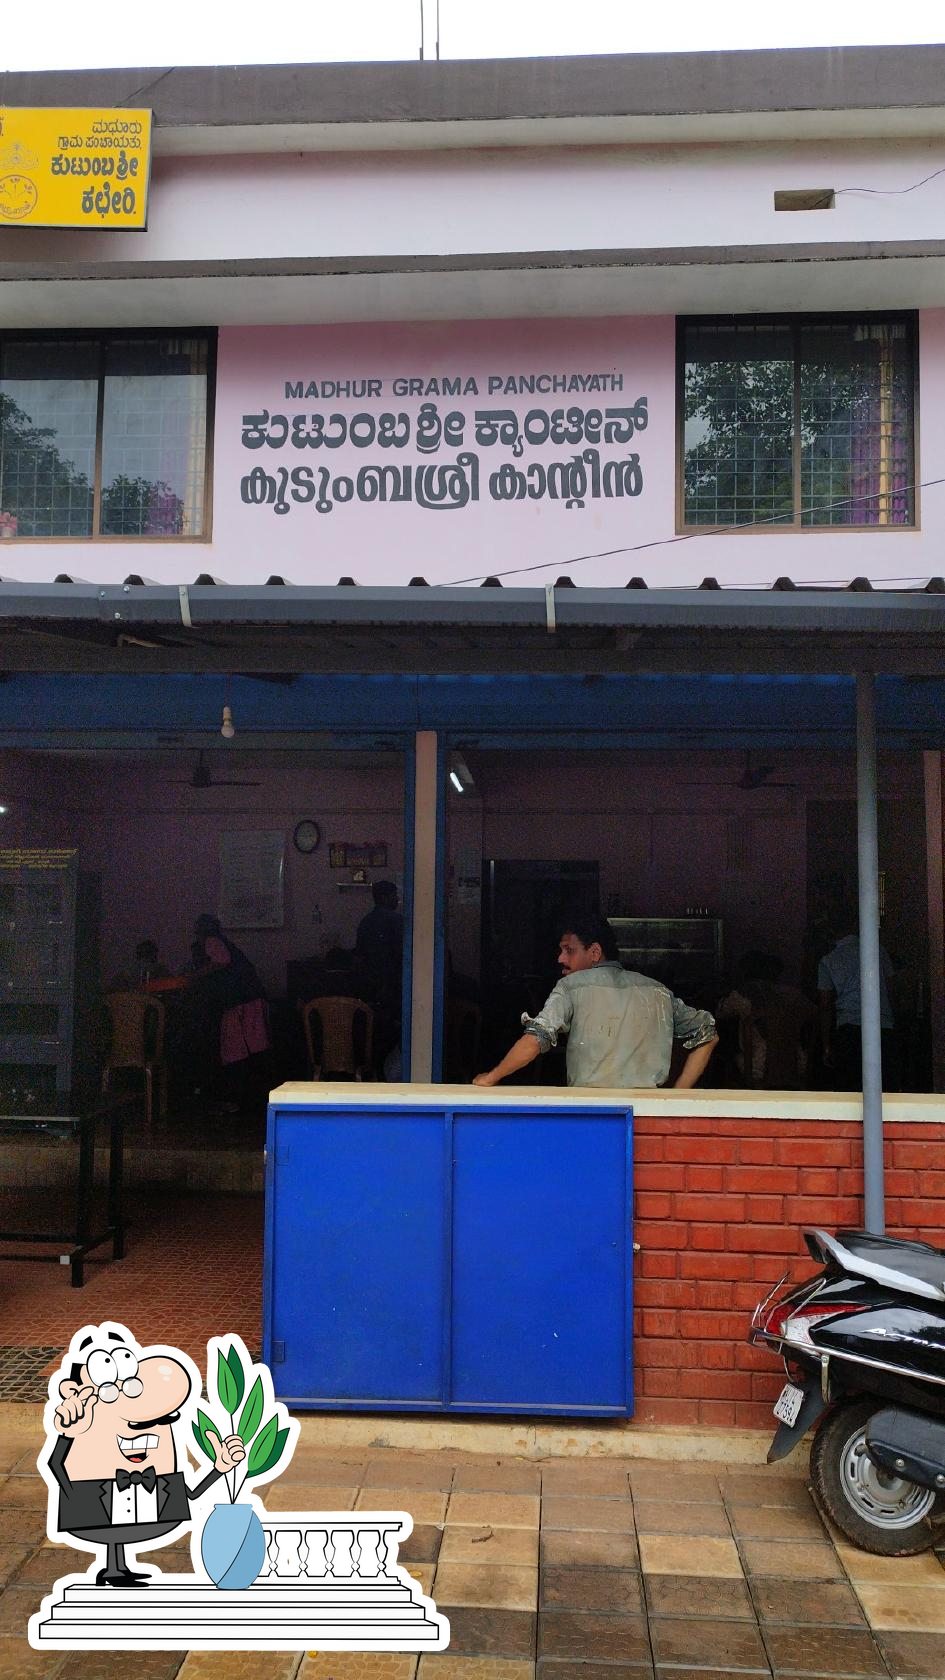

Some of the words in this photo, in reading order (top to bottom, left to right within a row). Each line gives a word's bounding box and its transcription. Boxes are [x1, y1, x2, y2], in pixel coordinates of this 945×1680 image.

[285, 379, 383, 399] MADHUR
[392, 377, 479, 397] GRAMA
[488, 373, 624, 395] PANCHAYATH
[474, 396, 649, 457] ಕ್ಯಾಂಟೀನ್
[240, 451, 480, 515] കുടുംബശ്രീ
